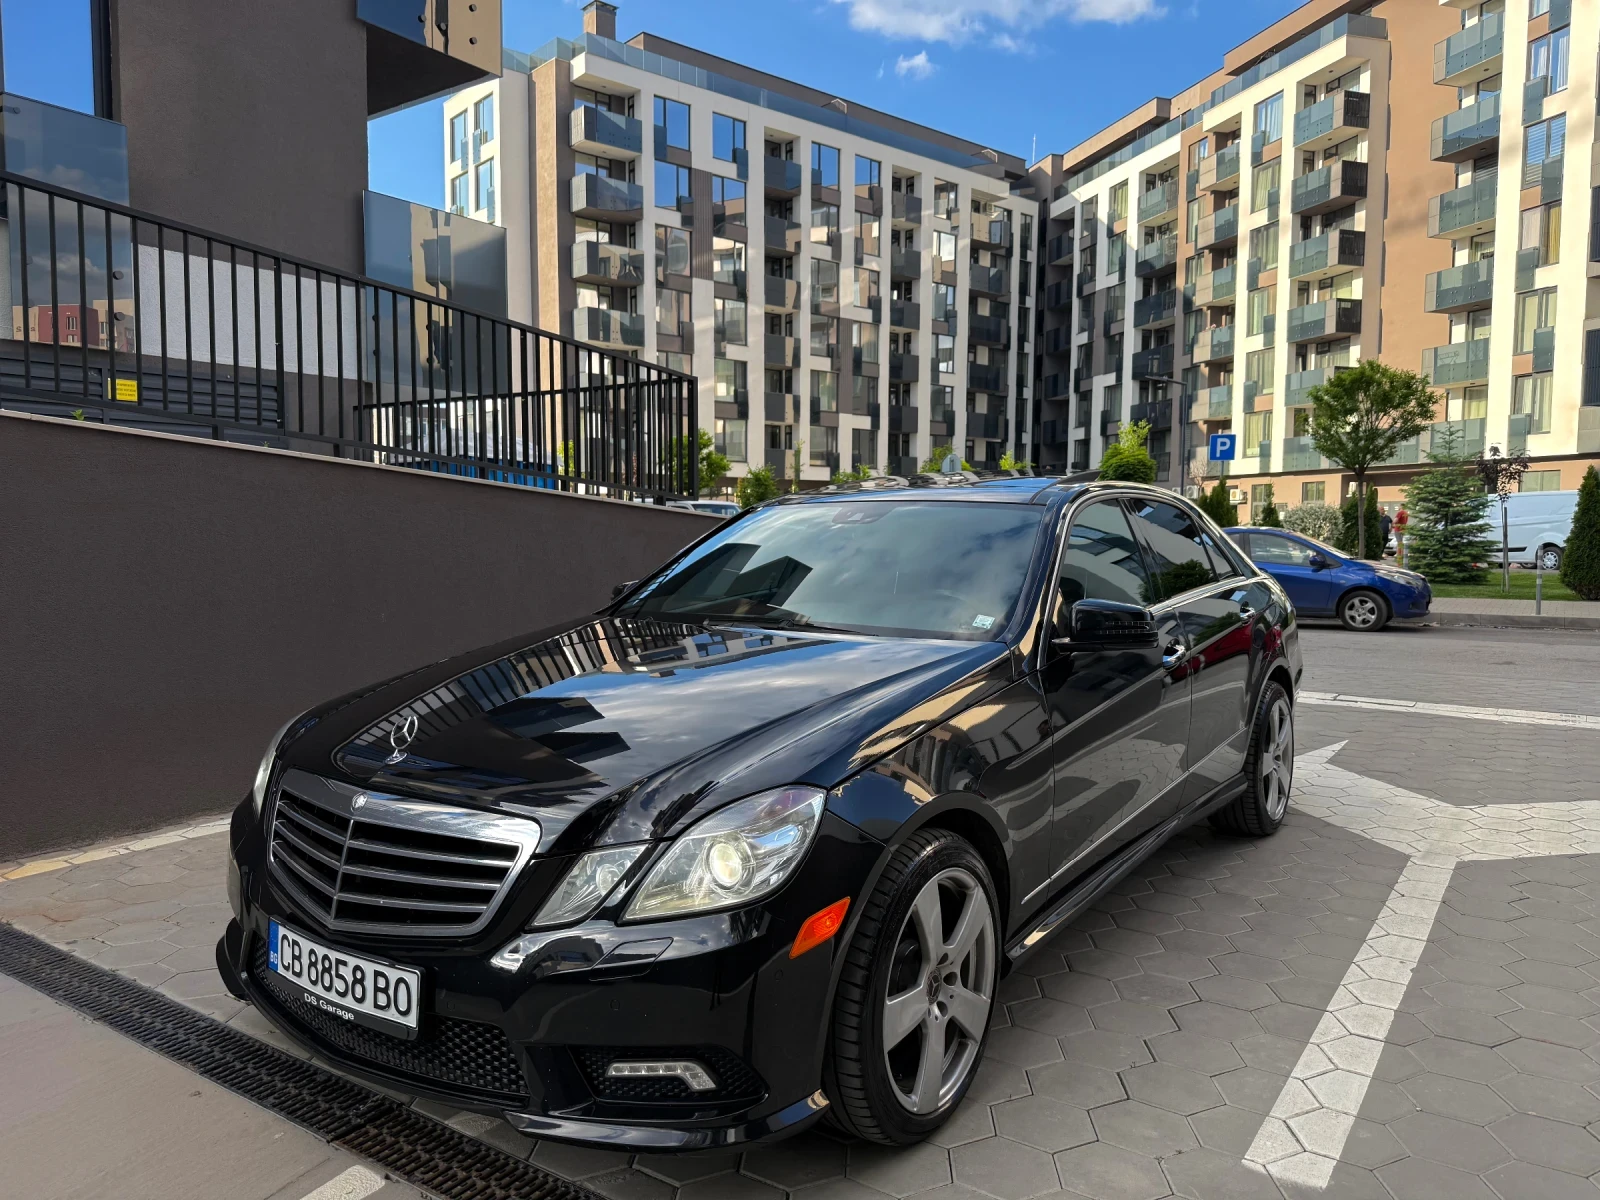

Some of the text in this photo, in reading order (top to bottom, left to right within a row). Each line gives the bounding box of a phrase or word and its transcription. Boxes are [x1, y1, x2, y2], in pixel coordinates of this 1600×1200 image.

[1216, 438, 1230, 457] P
[270, 951, 278, 964] BG
[281, 933, 412, 1016] CB 8858 BO
[304, 992, 355, 1020] DS Garage
